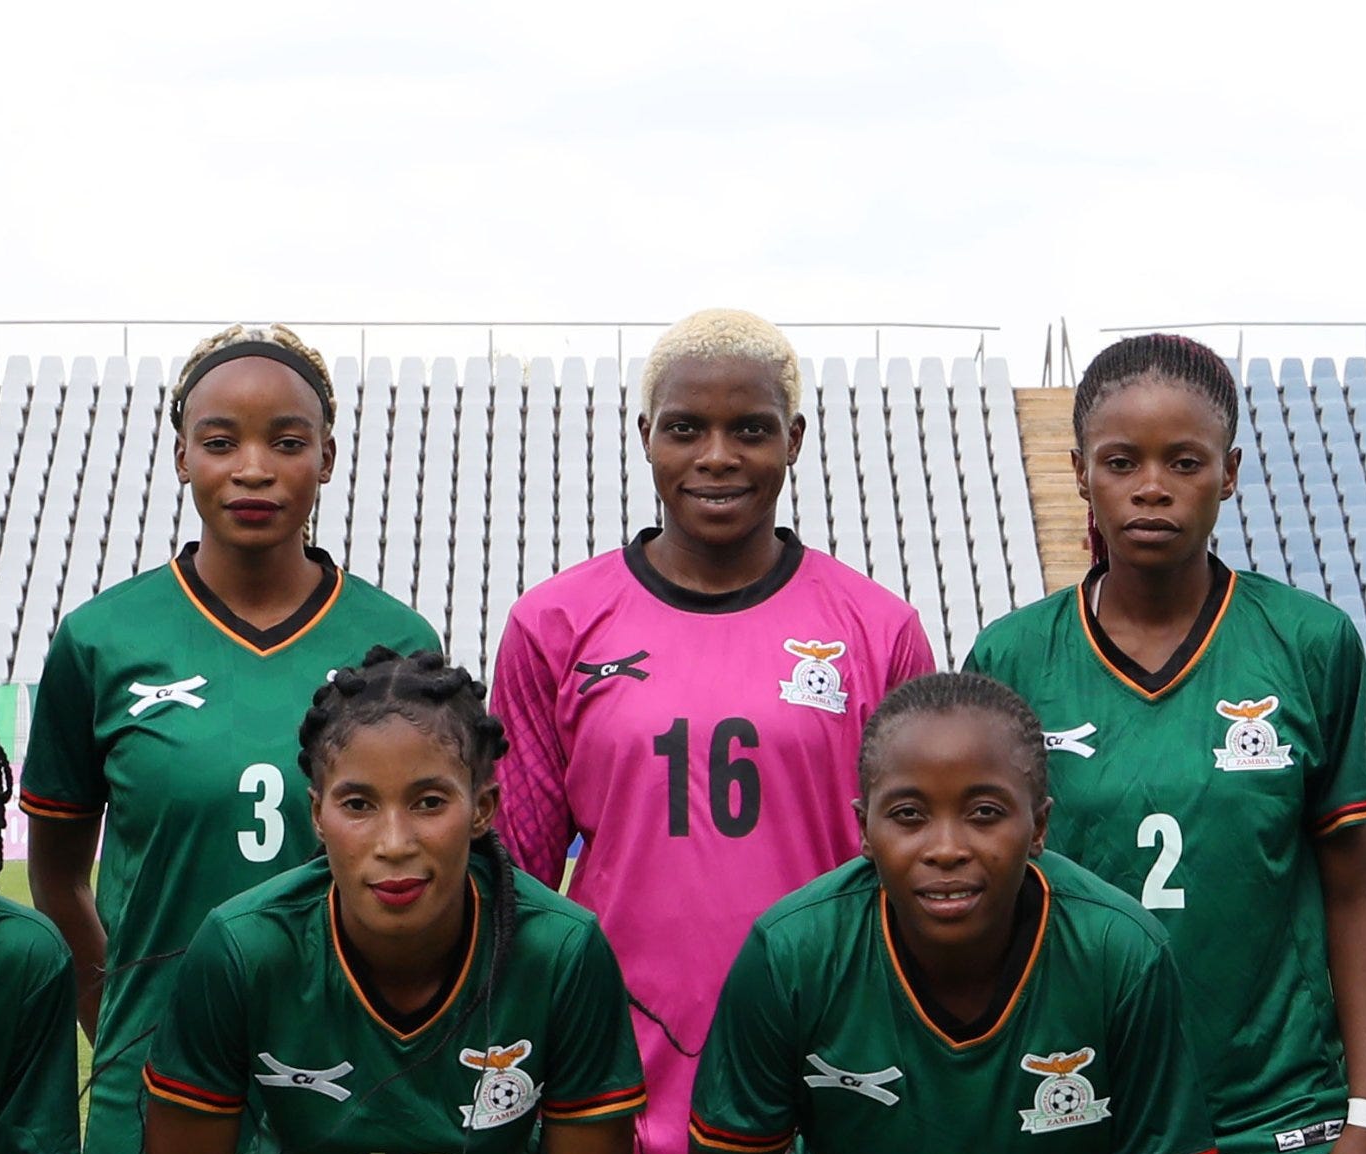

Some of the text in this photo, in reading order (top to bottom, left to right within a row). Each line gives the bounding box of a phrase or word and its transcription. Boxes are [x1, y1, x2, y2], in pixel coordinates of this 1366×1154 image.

[600, 664, 619, 676] Cu
[801, 694, 831, 705] ZAMBIA
[1236, 758, 1270, 766] ZAMBIA
[653, 717, 761, 839] 16
[237, 763, 285, 862] 3
[1137, 813, 1185, 909] 2
[292, 1073, 315, 1085] Cu
[840, 1075, 863, 1087] Cu
[487, 1107, 524, 1123] ZAMBIA
[1046, 1114, 1085, 1126] ZAMBIA
